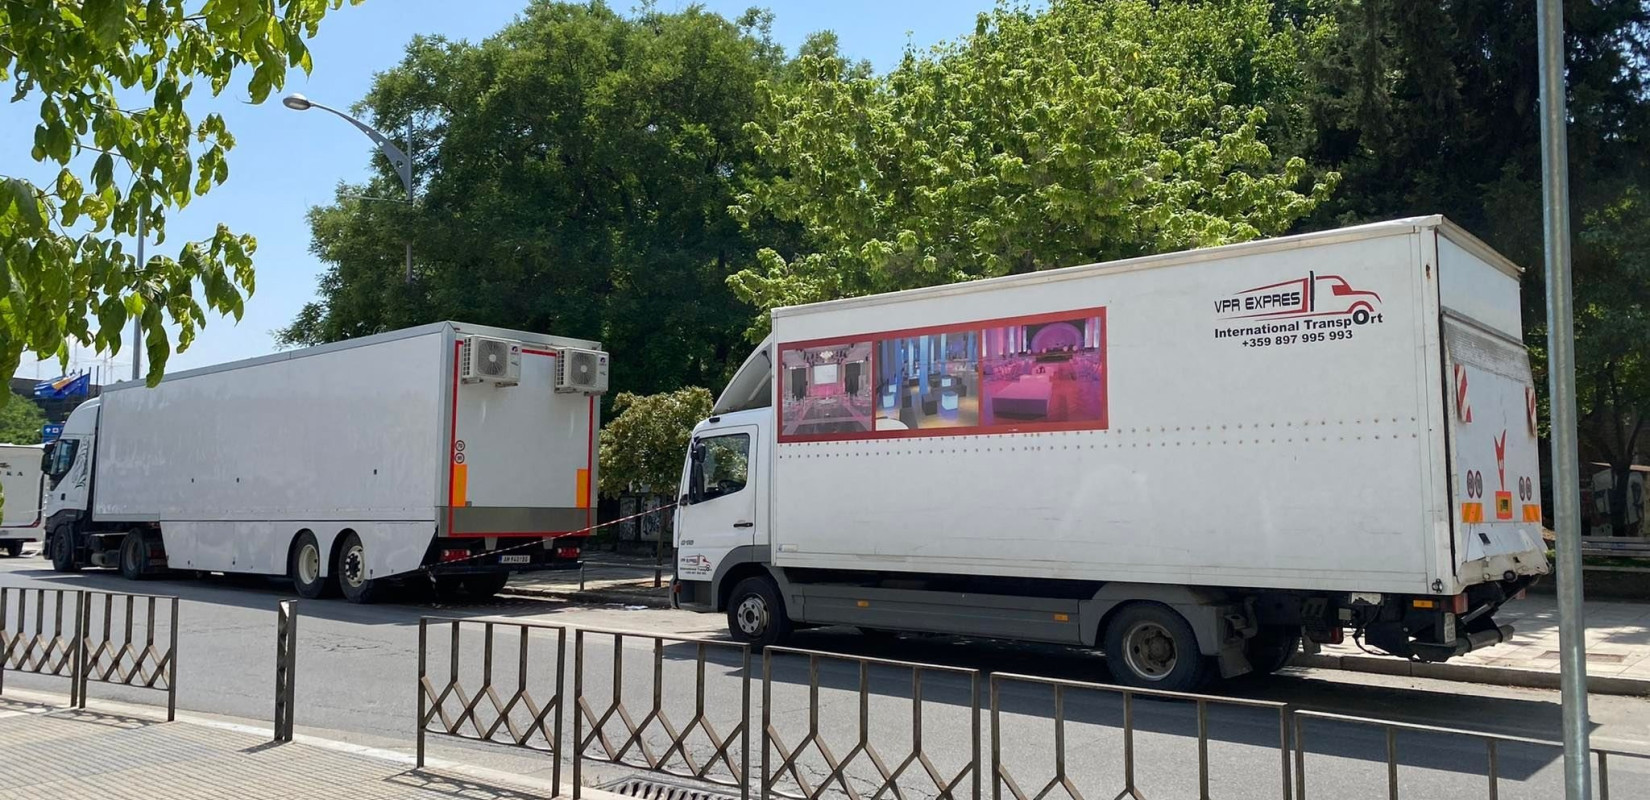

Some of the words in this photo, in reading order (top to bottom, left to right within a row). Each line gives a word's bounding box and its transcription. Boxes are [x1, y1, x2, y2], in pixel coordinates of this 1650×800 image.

[1214, 298, 1241, 313] VPR
[1245, 291, 1301, 311] EXPRES
[1214, 321, 1300, 338] International
[1242, 337, 1272, 348] +359
[1275, 334, 1298, 345] 897
[1301, 331, 1325, 343] 995
[1329, 329, 1353, 340] 993
